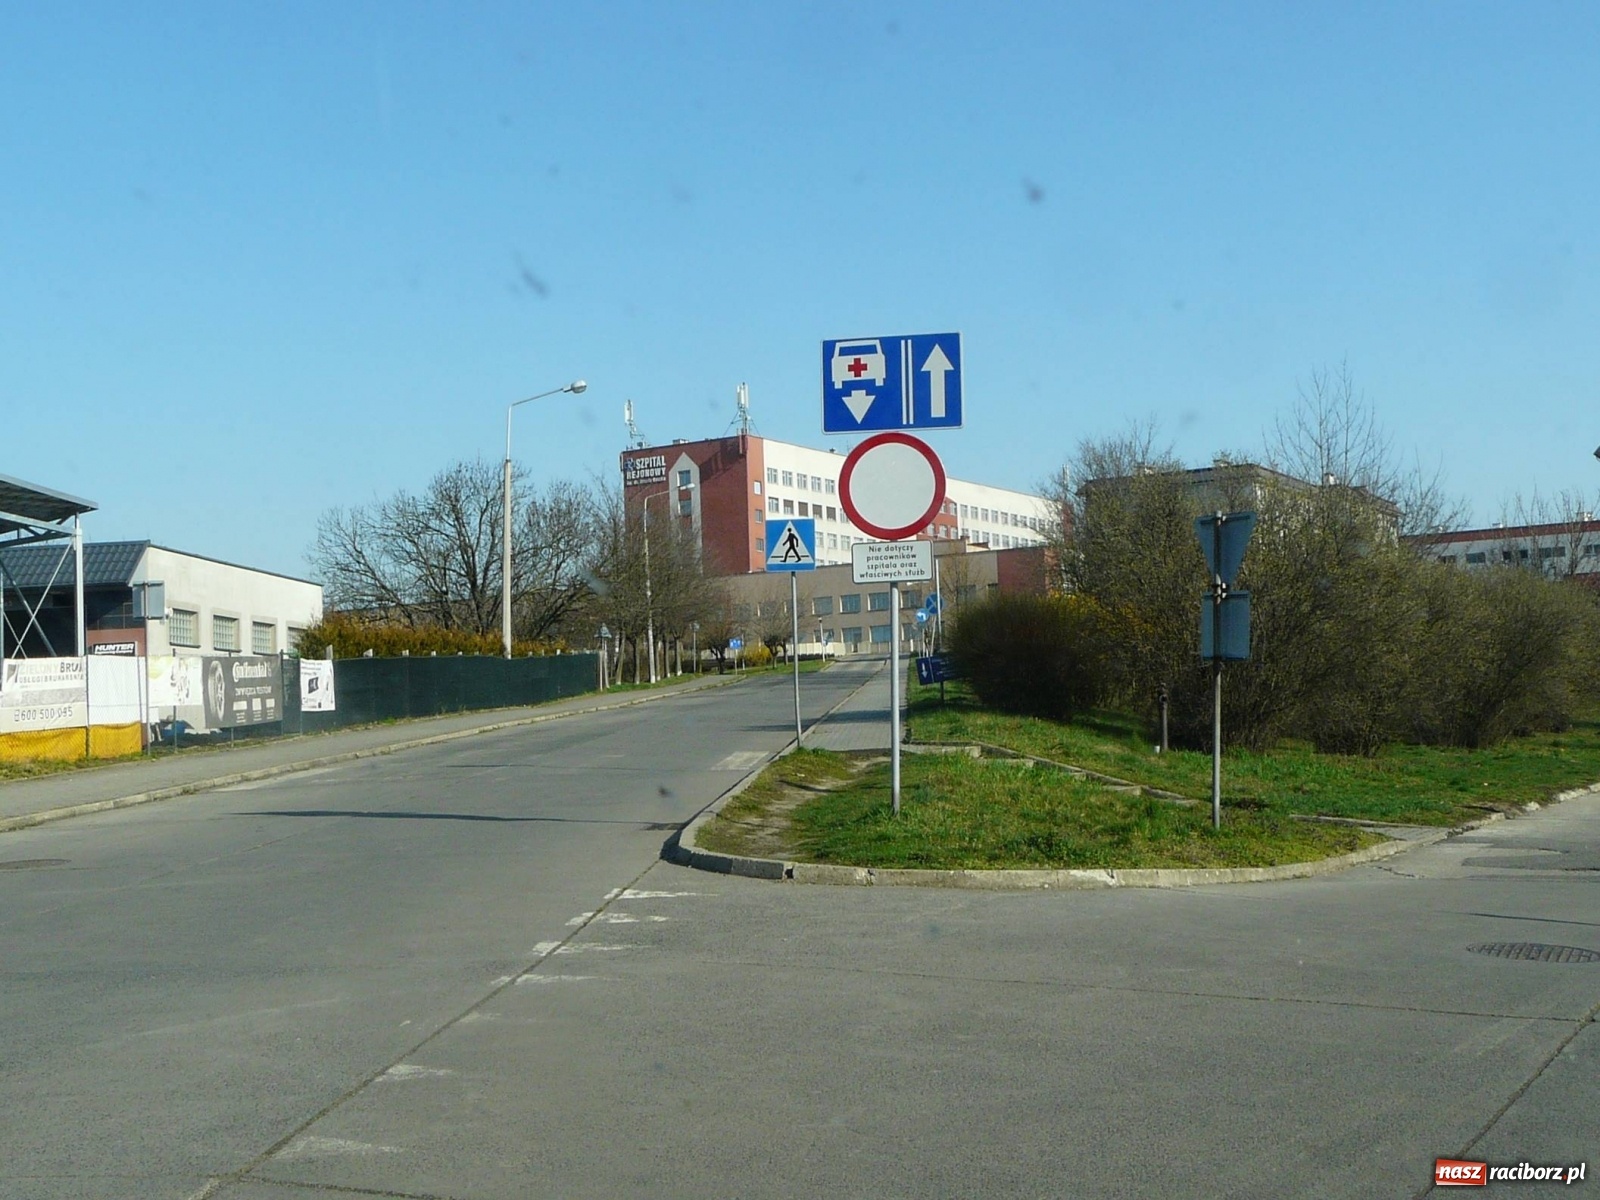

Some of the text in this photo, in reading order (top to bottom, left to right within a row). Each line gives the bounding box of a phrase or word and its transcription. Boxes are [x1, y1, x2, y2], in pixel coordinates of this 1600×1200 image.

[635, 455, 666, 469] SZPITAL
[626, 467, 666, 479] REJONOWY
[884, 544, 914, 552] dotyczy
[867, 562, 897, 571] szpitala
[95, 643, 135, 652] HUNTER
[21, 709, 37, 721] 600
[40, 708, 55, 720] 500
